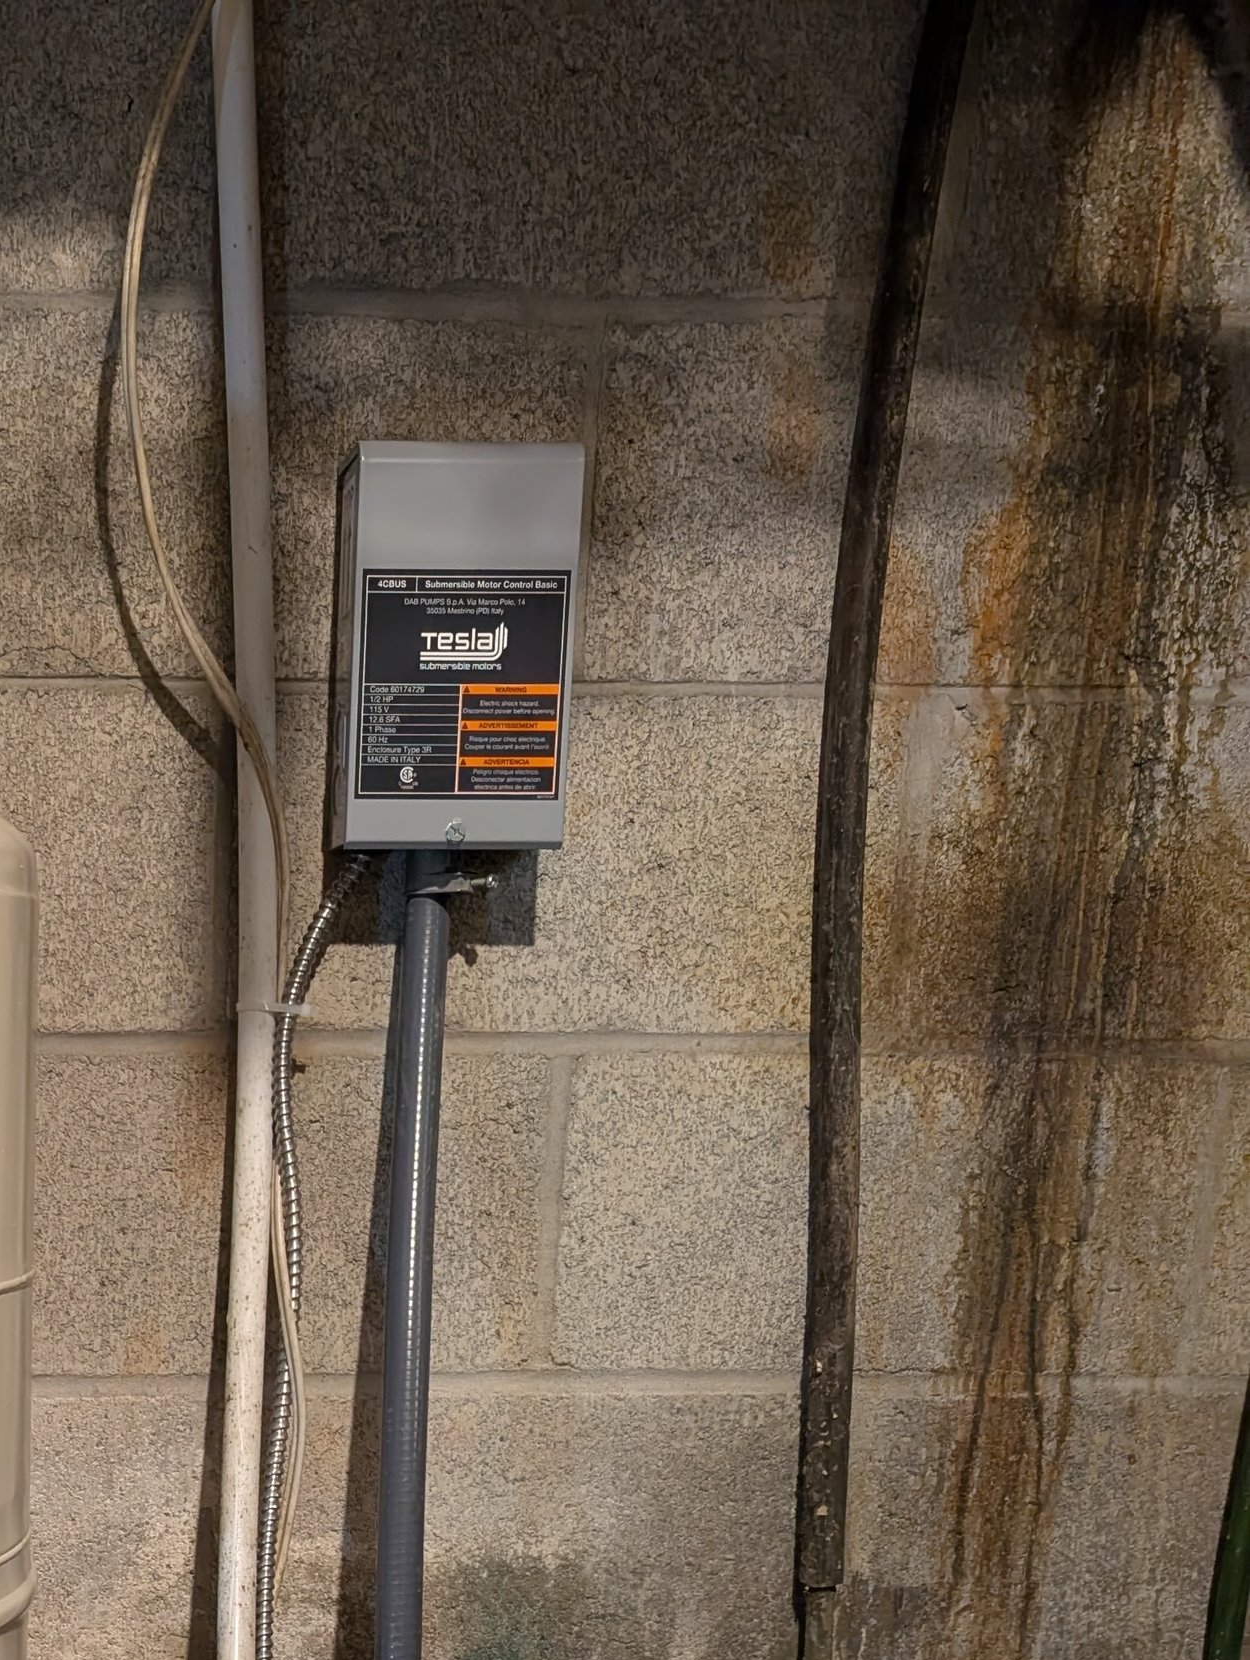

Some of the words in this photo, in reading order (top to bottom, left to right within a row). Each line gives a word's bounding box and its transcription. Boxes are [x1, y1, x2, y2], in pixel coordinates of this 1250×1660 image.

[378, 580, 407, 588] 4CBUS
[425, 580, 475, 588] Submersible
[477, 580, 502, 588] Motor
[503, 580, 533, 588] Control
[535, 580, 558, 588] Basic
[491, 607, 504, 615] Italy
[420, 662, 470, 670] submersible
[472, 662, 502, 670] motors
[403, 746, 421, 755] Type
